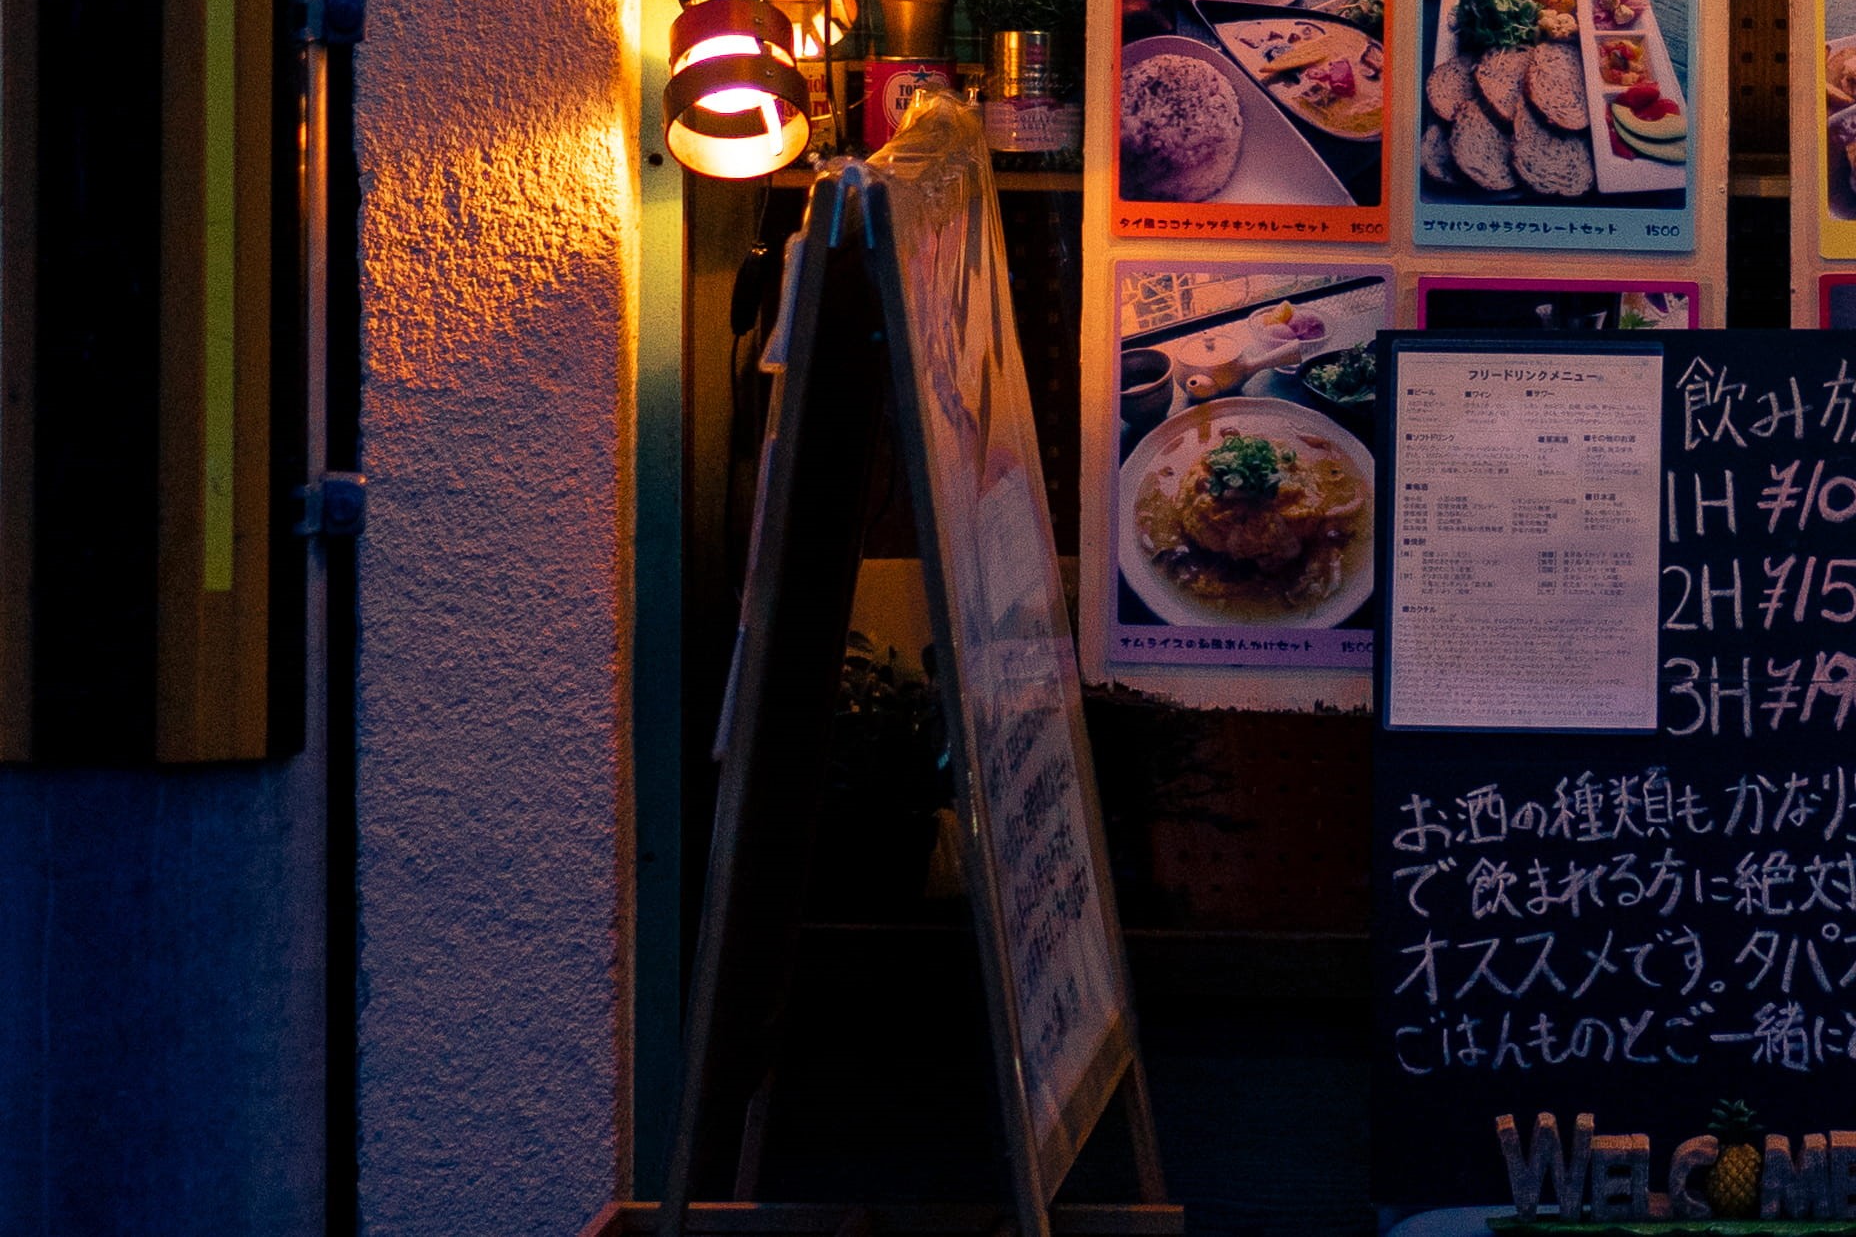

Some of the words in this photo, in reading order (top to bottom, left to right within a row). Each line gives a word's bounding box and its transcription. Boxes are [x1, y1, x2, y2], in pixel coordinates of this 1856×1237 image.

[1350, 222, 1384, 234] 1500
[1645, 224, 1680, 237] 1500
[1468, 369, 1597, 382] フリードリンクメニュー
[1472, 391, 1492, 399] ワイン
[1666, 468, 1737, 543] 1H
[1662, 557, 1744, 631] 2H
[1664, 655, 1752, 738] 3H
